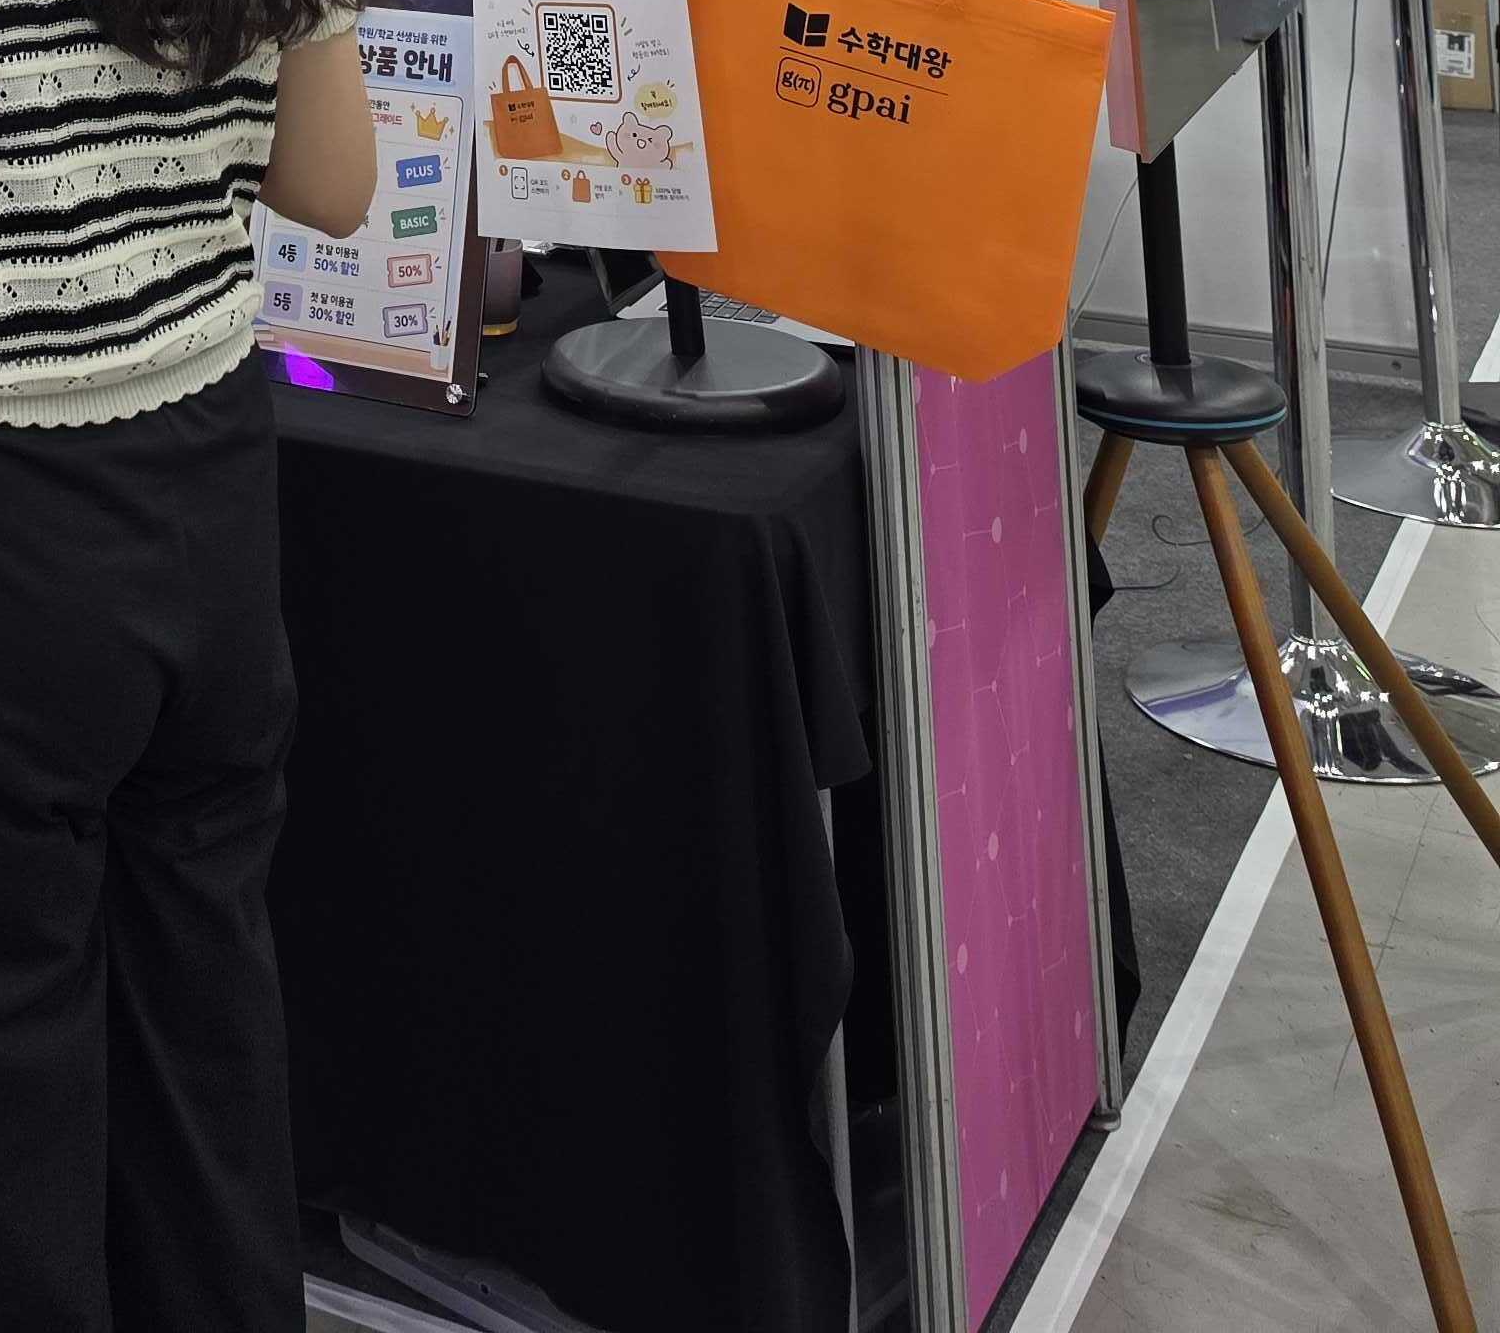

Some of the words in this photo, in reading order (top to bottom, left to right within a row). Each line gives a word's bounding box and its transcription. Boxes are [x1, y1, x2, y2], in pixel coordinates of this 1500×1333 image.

[396, 30, 429, 44] 선생님을
[430, 34, 447, 46] 위한
[836, 25, 953, 80] 수학대왕
[403, 49, 453, 83] 안내
[827, 78, 912, 125] gpai
[405, 164, 434, 180] PLUS
[399, 216, 429, 230] BASIC
[278, 244, 299, 263] 4등
[315, 243, 325, 254] 첫
[325, 245, 334, 255] 달
[335, 247, 359, 260] 이용권
[313, 258, 338, 273] 50%
[340, 261, 360, 276] 할인
[398, 264, 422, 278] 50%
[273, 292, 292, 311] 5등
[309, 291, 319, 303] 첫
[320, 293, 329, 304] 달
[331, 295, 354, 309] 이용권
[308, 306, 333, 322] 30%
[335, 309, 355, 326] 할인
[394, 314, 418, 328] 30%
